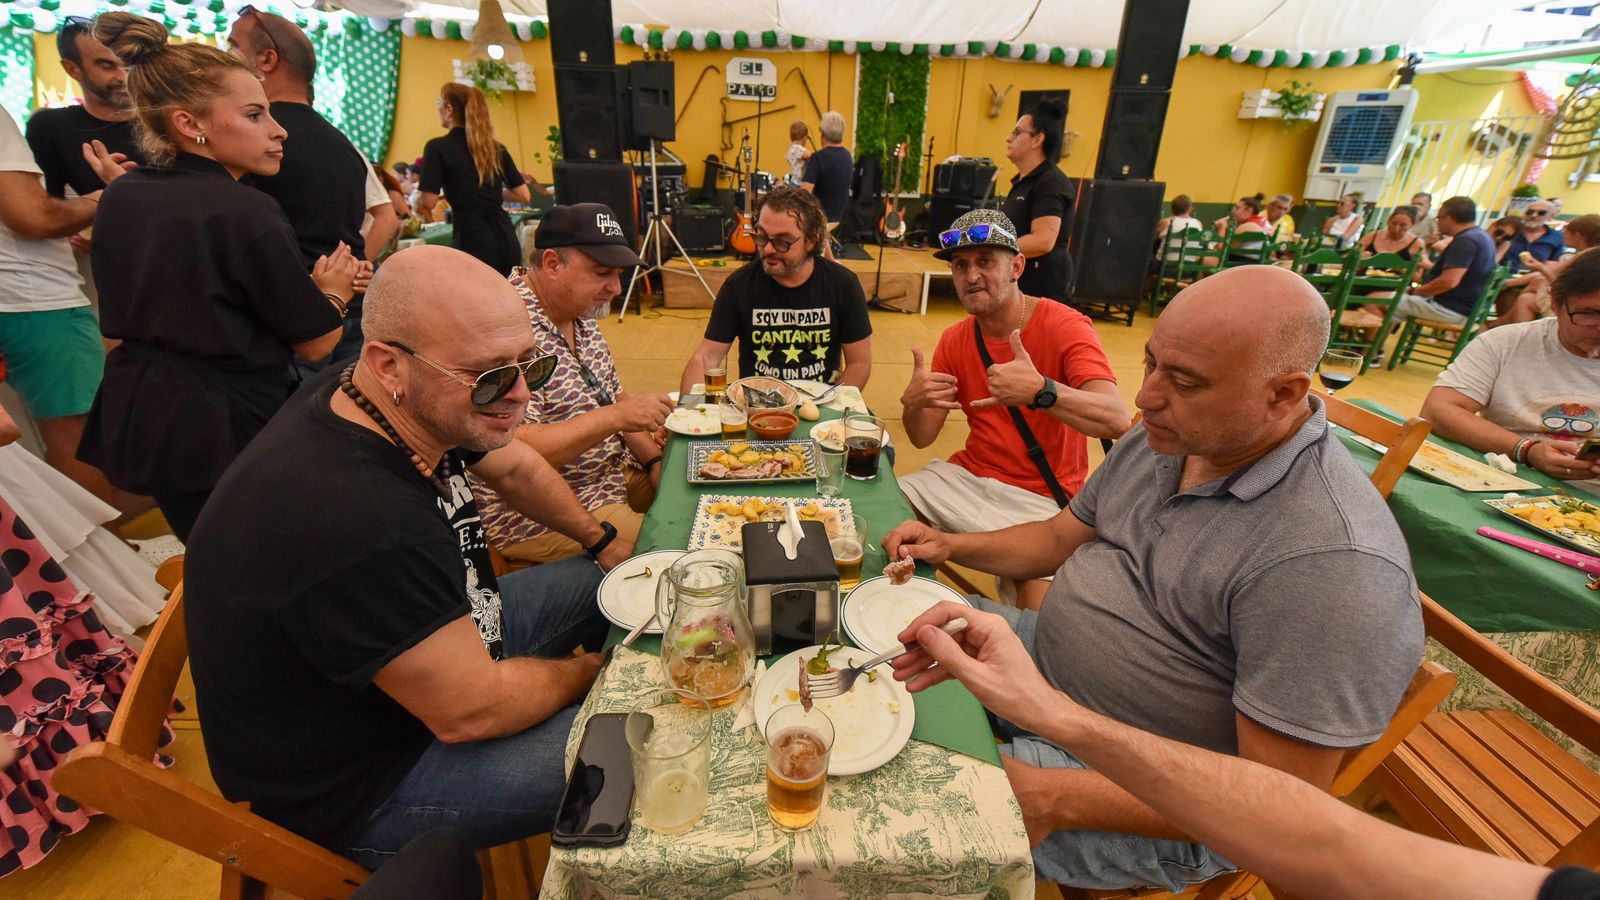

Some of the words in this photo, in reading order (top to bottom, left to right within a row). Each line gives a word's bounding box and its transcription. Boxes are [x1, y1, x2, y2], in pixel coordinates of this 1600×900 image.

[741, 62, 761, 74] EL
[756, 311, 779, 324] SOY
[781, 311, 796, 323] UN
[752, 329, 831, 344] CANTANTE
[782, 368, 799, 379] UN
